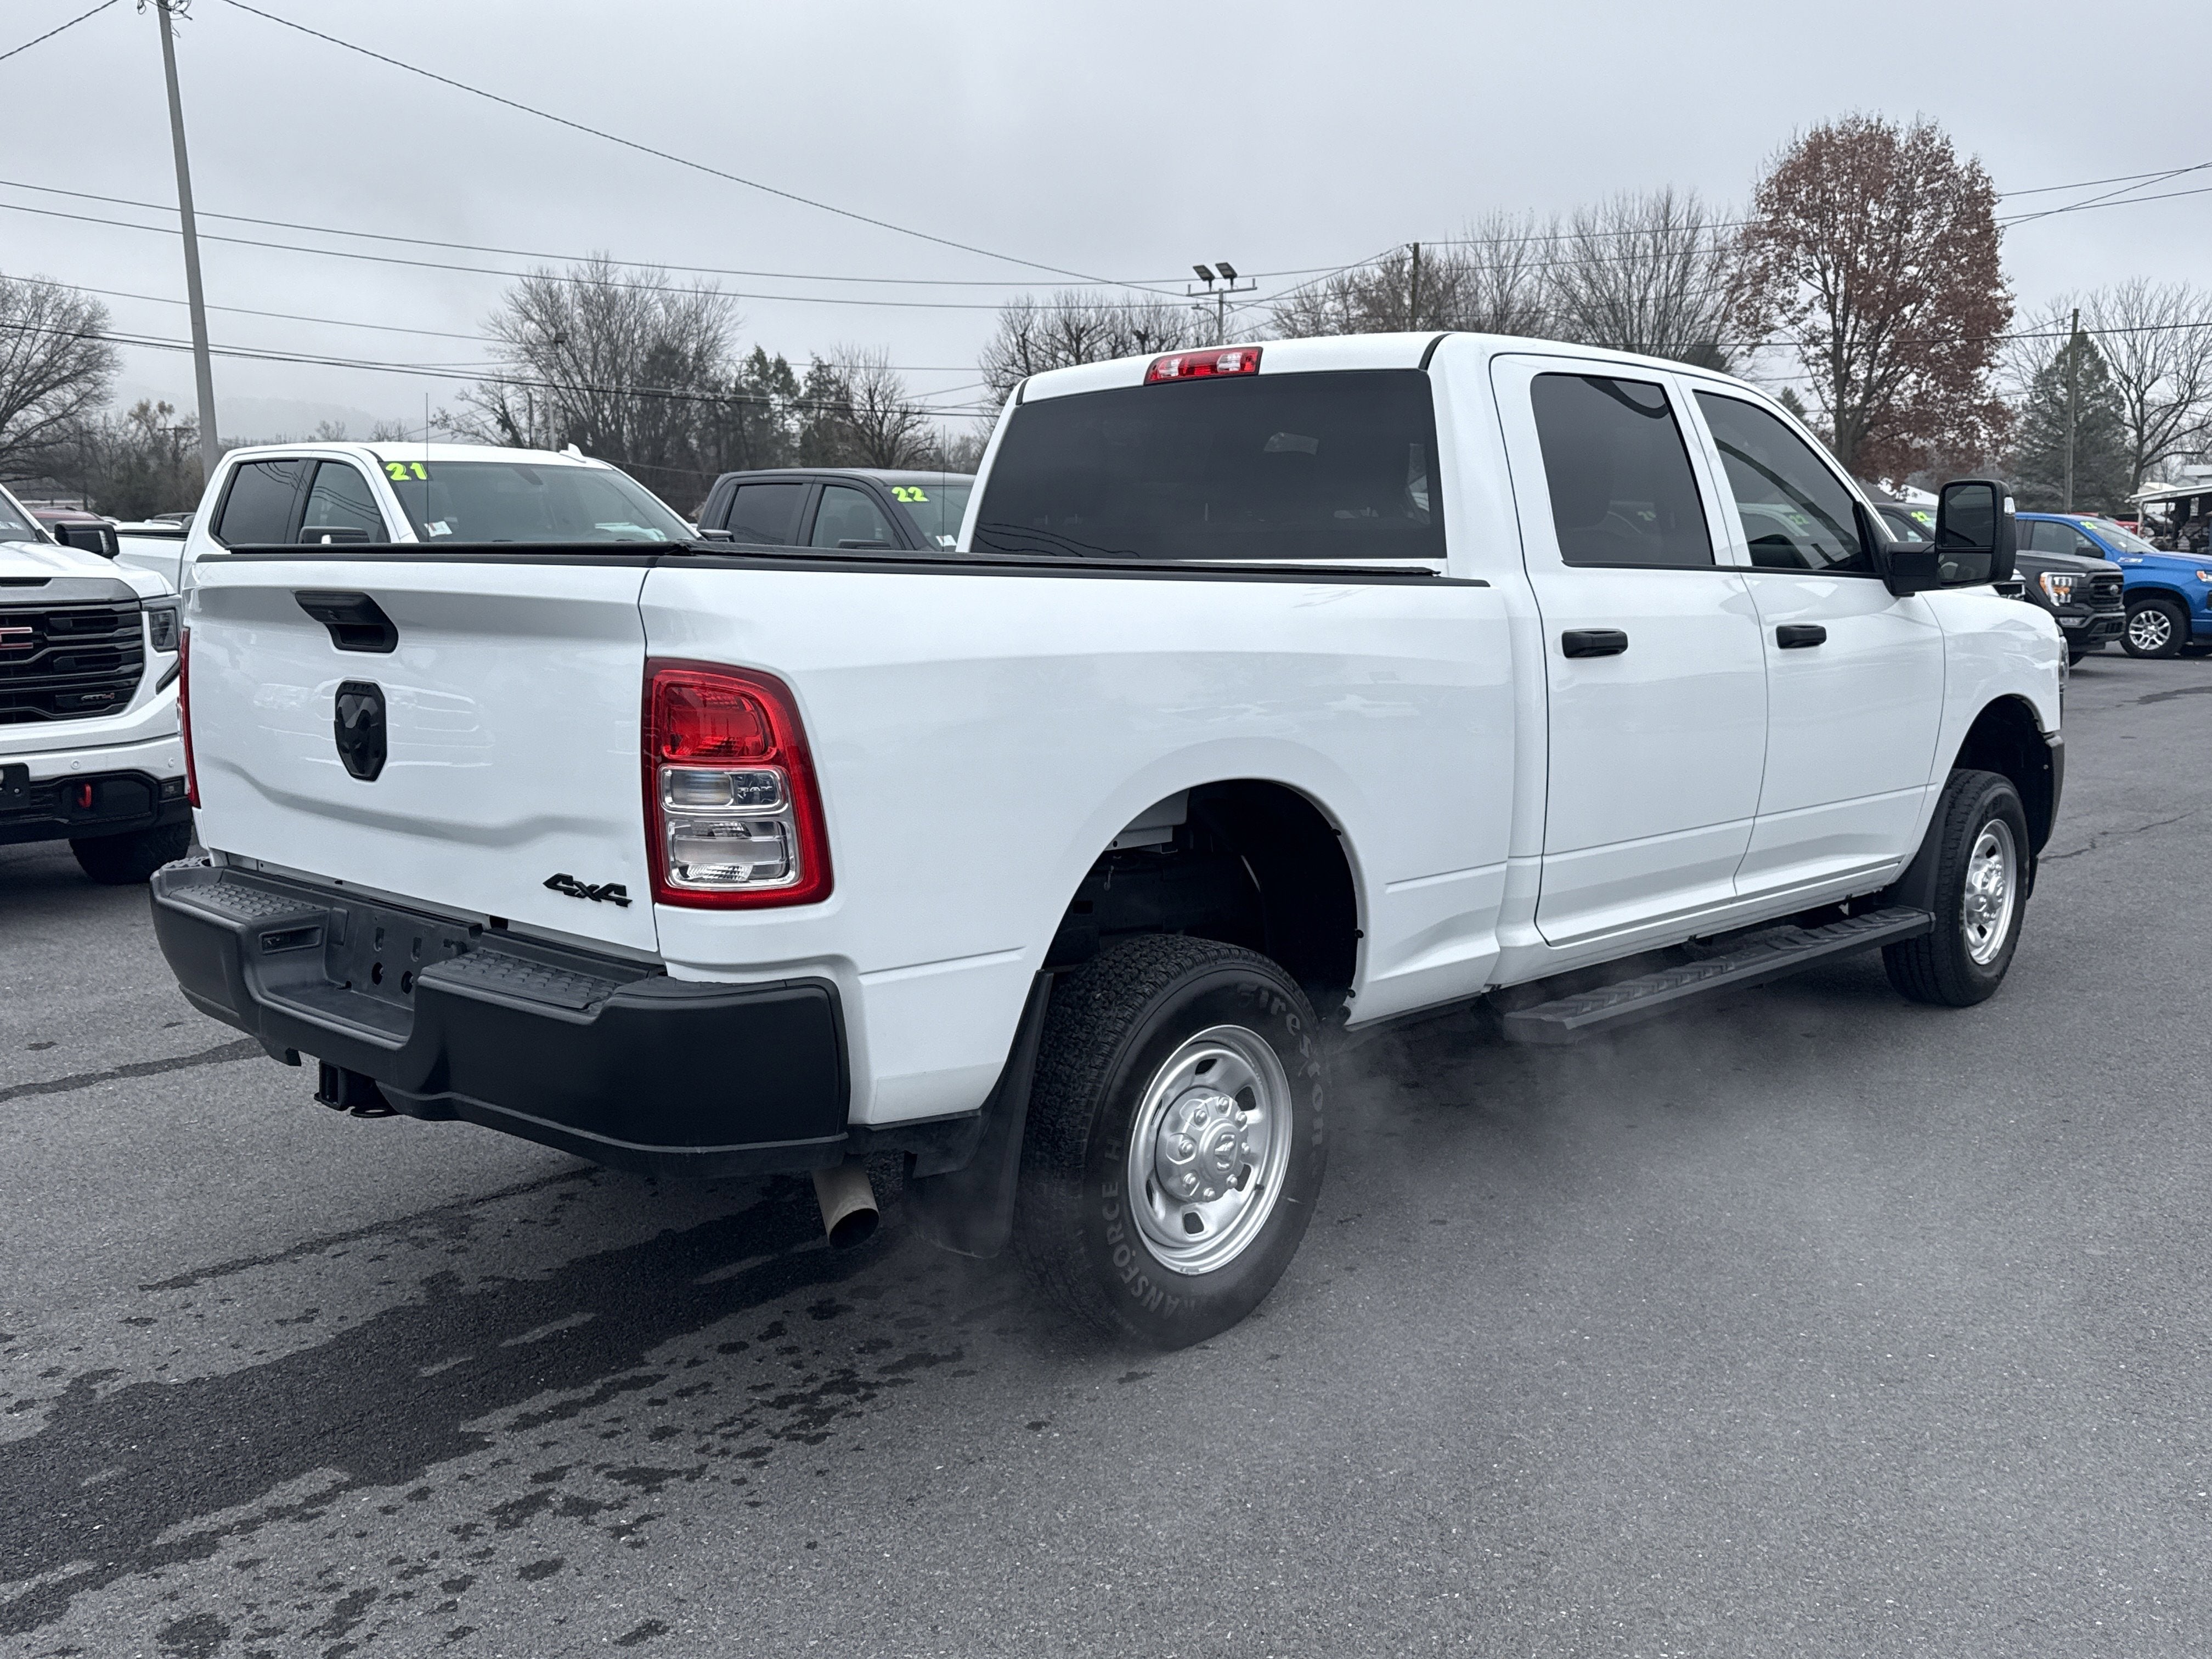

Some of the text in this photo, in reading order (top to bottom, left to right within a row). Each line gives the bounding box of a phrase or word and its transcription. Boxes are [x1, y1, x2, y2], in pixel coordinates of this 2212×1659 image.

[385, 462, 427, 481] 21
[891, 487, 930, 502] 22
[1911, 511, 1932, 522] 22
